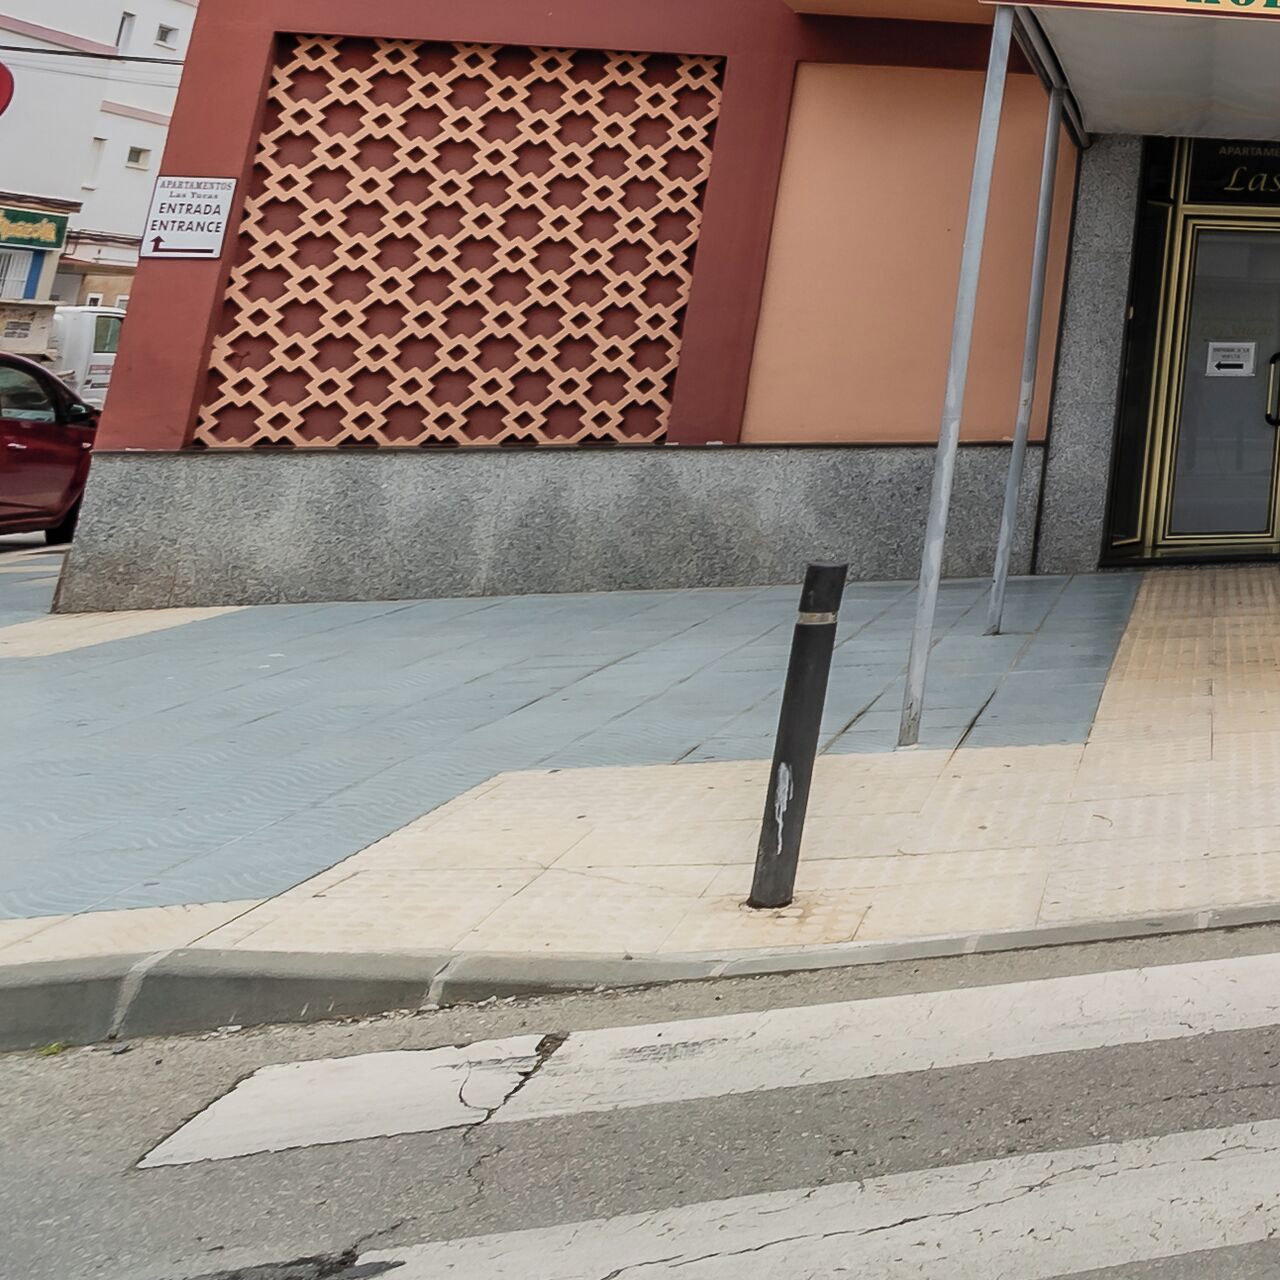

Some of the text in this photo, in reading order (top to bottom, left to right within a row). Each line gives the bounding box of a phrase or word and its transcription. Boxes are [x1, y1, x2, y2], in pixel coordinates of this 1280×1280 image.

[160, 180, 232, 190] APARTAMENTOS
[159, 202, 221, 215] ENTRADA
[150, 220, 223, 233] ENTRANCE
